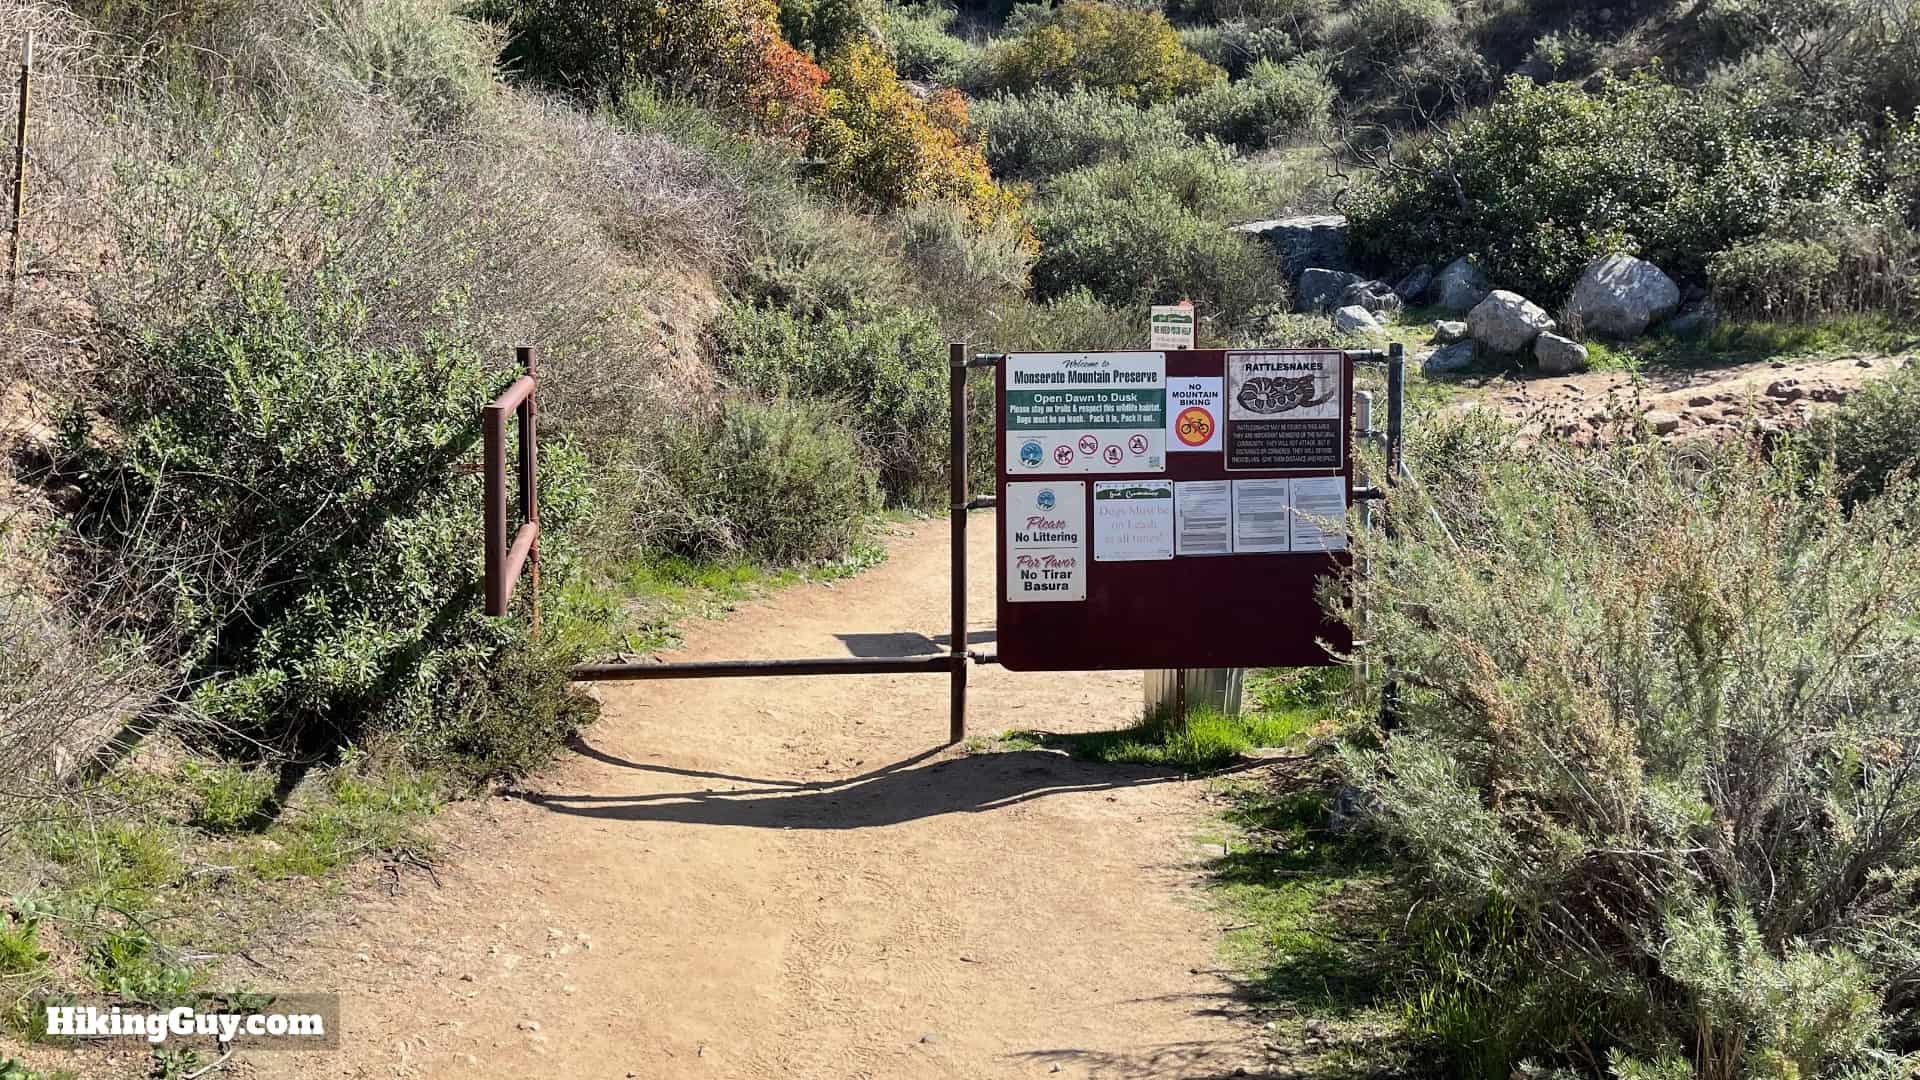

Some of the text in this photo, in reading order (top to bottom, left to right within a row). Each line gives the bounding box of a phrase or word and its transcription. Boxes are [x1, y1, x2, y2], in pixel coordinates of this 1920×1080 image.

[1062, 360, 1098, 368] Welcome
[1246, 362, 1323, 371] RATTLESNAKES
[1014, 370, 1158, 384] Monserate Mountain Preserve
[1034, 392, 1138, 405] Open Dawn to Dusk
[1010, 405, 1030, 413] Please
[1031, 405, 1044, 414] stay
[1055, 404, 1071, 413] trails
[1073, 404, 1077, 412] &
[1079, 404, 1102, 414] respect
[1116, 404, 1138, 412] wildlife
[1017, 416, 1031, 424] Dogs
[1089, 414, 1104, 422] Pack
[1106, 414, 1111, 422] it
[1121, 414, 1136, 422] Pack
[1137, 414, 1142, 422] it
[1026, 516, 1066, 529] Please
[1015, 532, 1078, 543] No Littering
[1016, 555, 1076, 568] Por Favor
[1020, 570, 1072, 580] No Tirar
[1024, 581, 1069, 591] Basura
